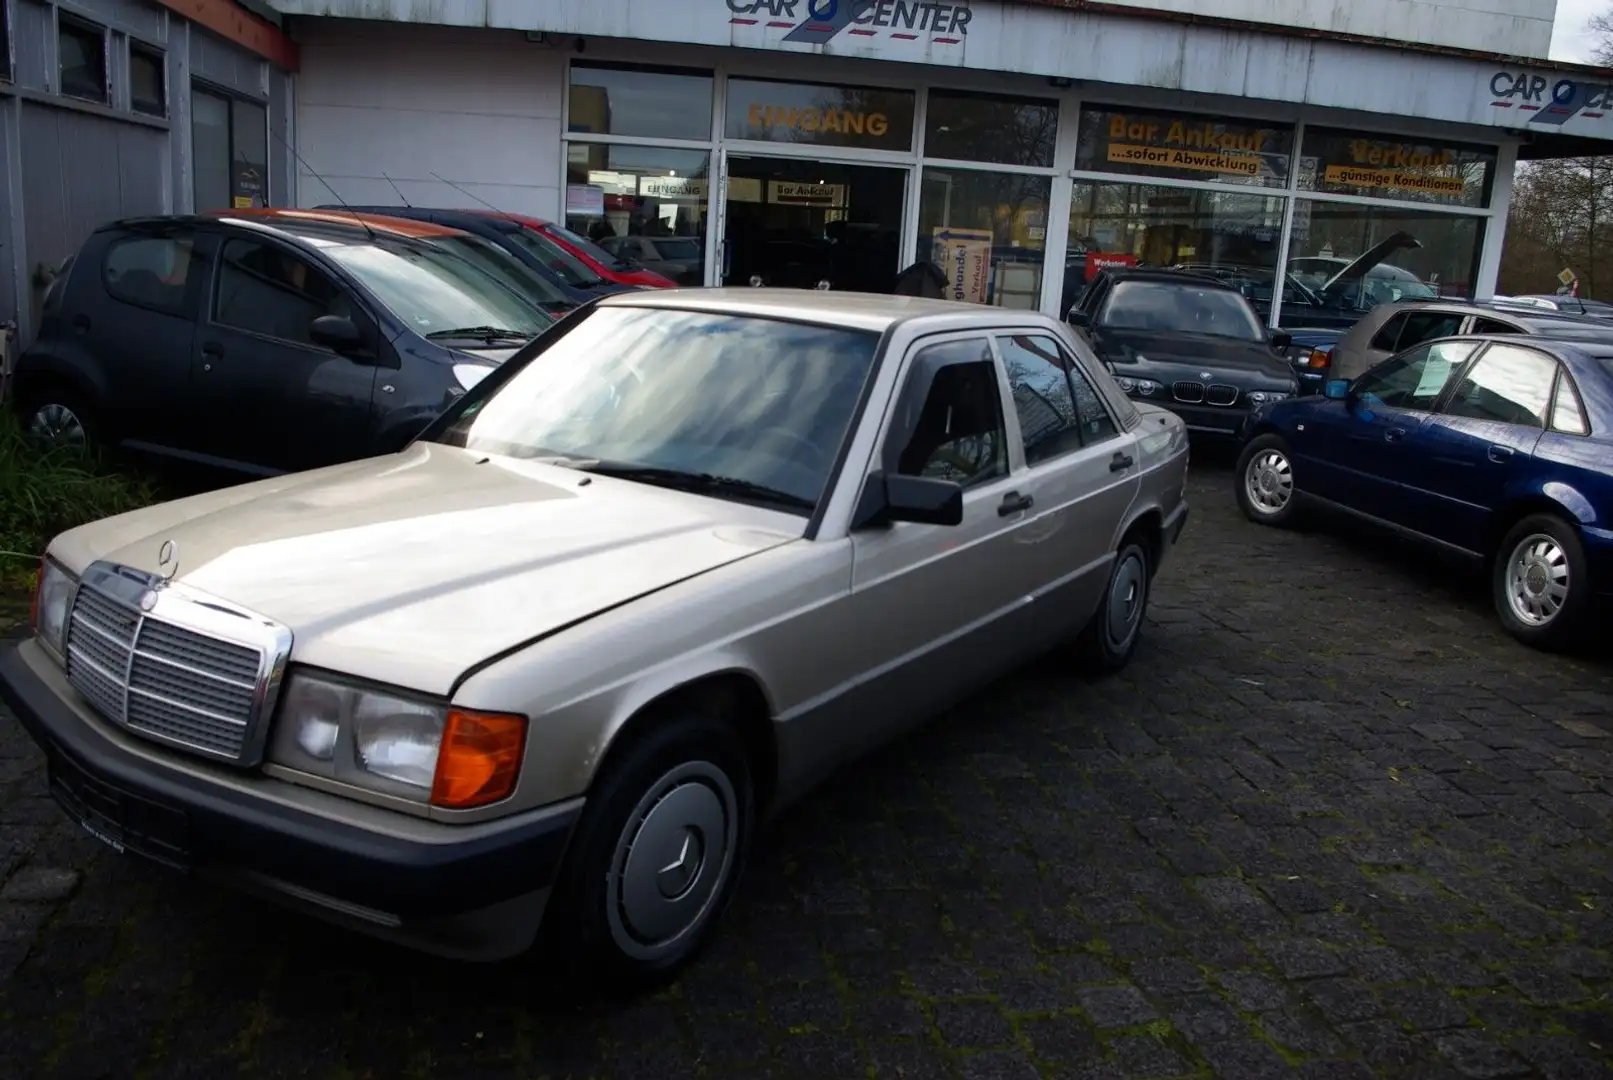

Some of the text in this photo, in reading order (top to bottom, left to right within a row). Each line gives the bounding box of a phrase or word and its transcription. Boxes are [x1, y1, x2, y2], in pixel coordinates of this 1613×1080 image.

[727, 0, 796, 18] CAR
[846, 0, 972, 35] CENTER
[1490, 72, 1547, 102] CAR
[747, 102, 889, 137] EINGANG
[1108, 114, 1267, 152] Bar Ankauf
[1173, 151, 1258, 175] Abwicklung
[1350, 138, 1456, 167] Verkauf
[1394, 174, 1463, 192] Konditionen
